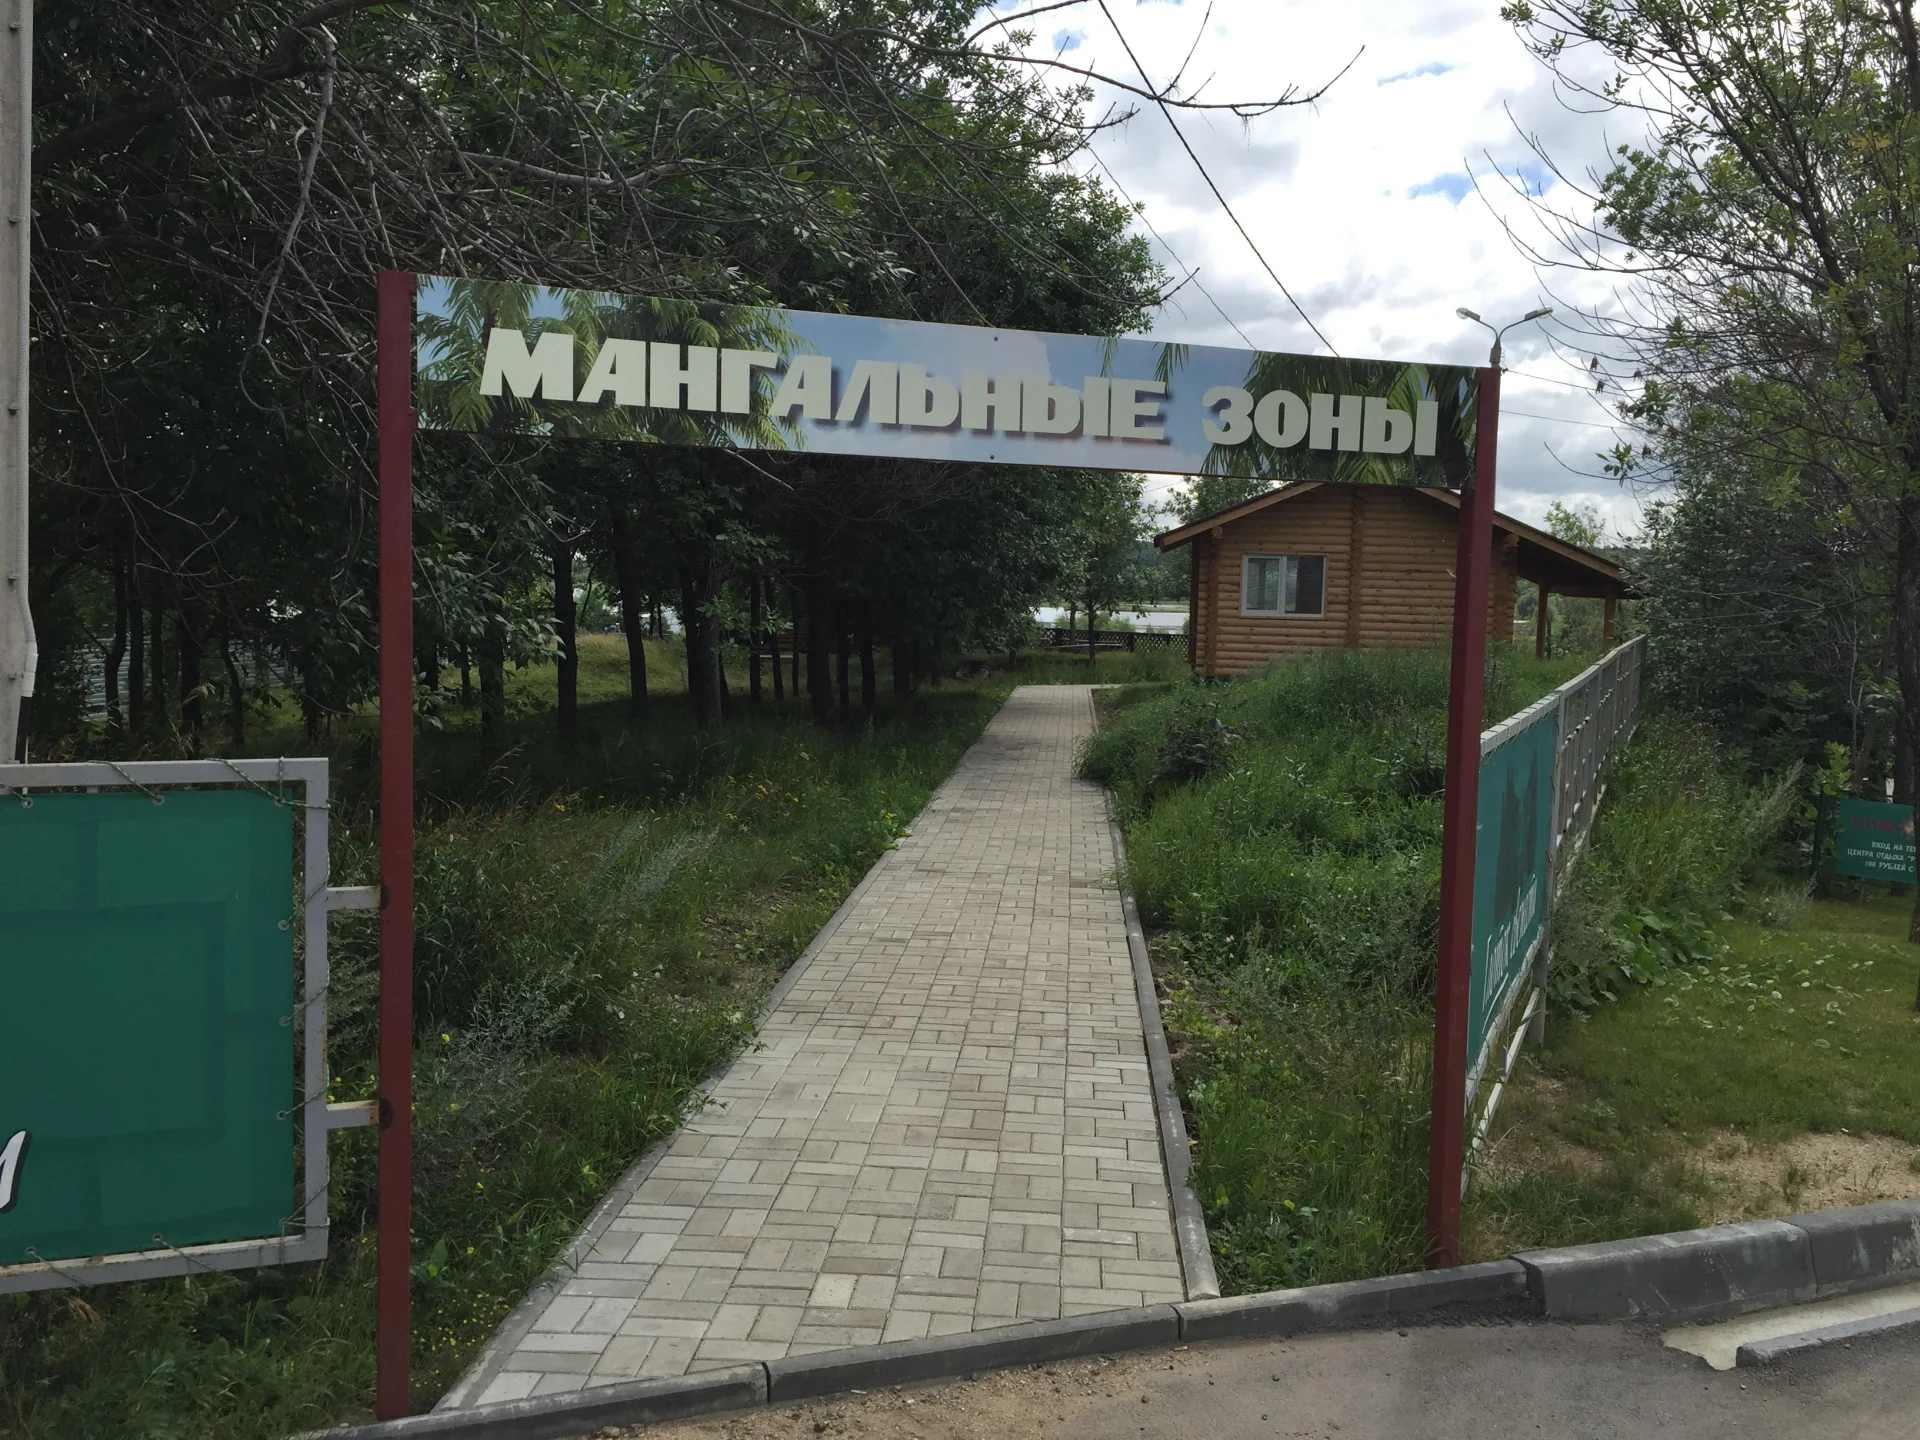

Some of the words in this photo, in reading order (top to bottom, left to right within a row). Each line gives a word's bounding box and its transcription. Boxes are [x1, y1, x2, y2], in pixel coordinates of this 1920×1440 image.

[481, 328, 1167, 441] МАНГАЛЬНЫЕ
[1202, 385, 1439, 456] ЗОНЫ
[1871, 841, 1891, 851] ВХОД
[1847, 848, 1874, 857] ЦЕНТРА
[1876, 852, 1904, 861] ОТДЫХА
[1879, 862, 1906, 871] РУБЛЕЙ
